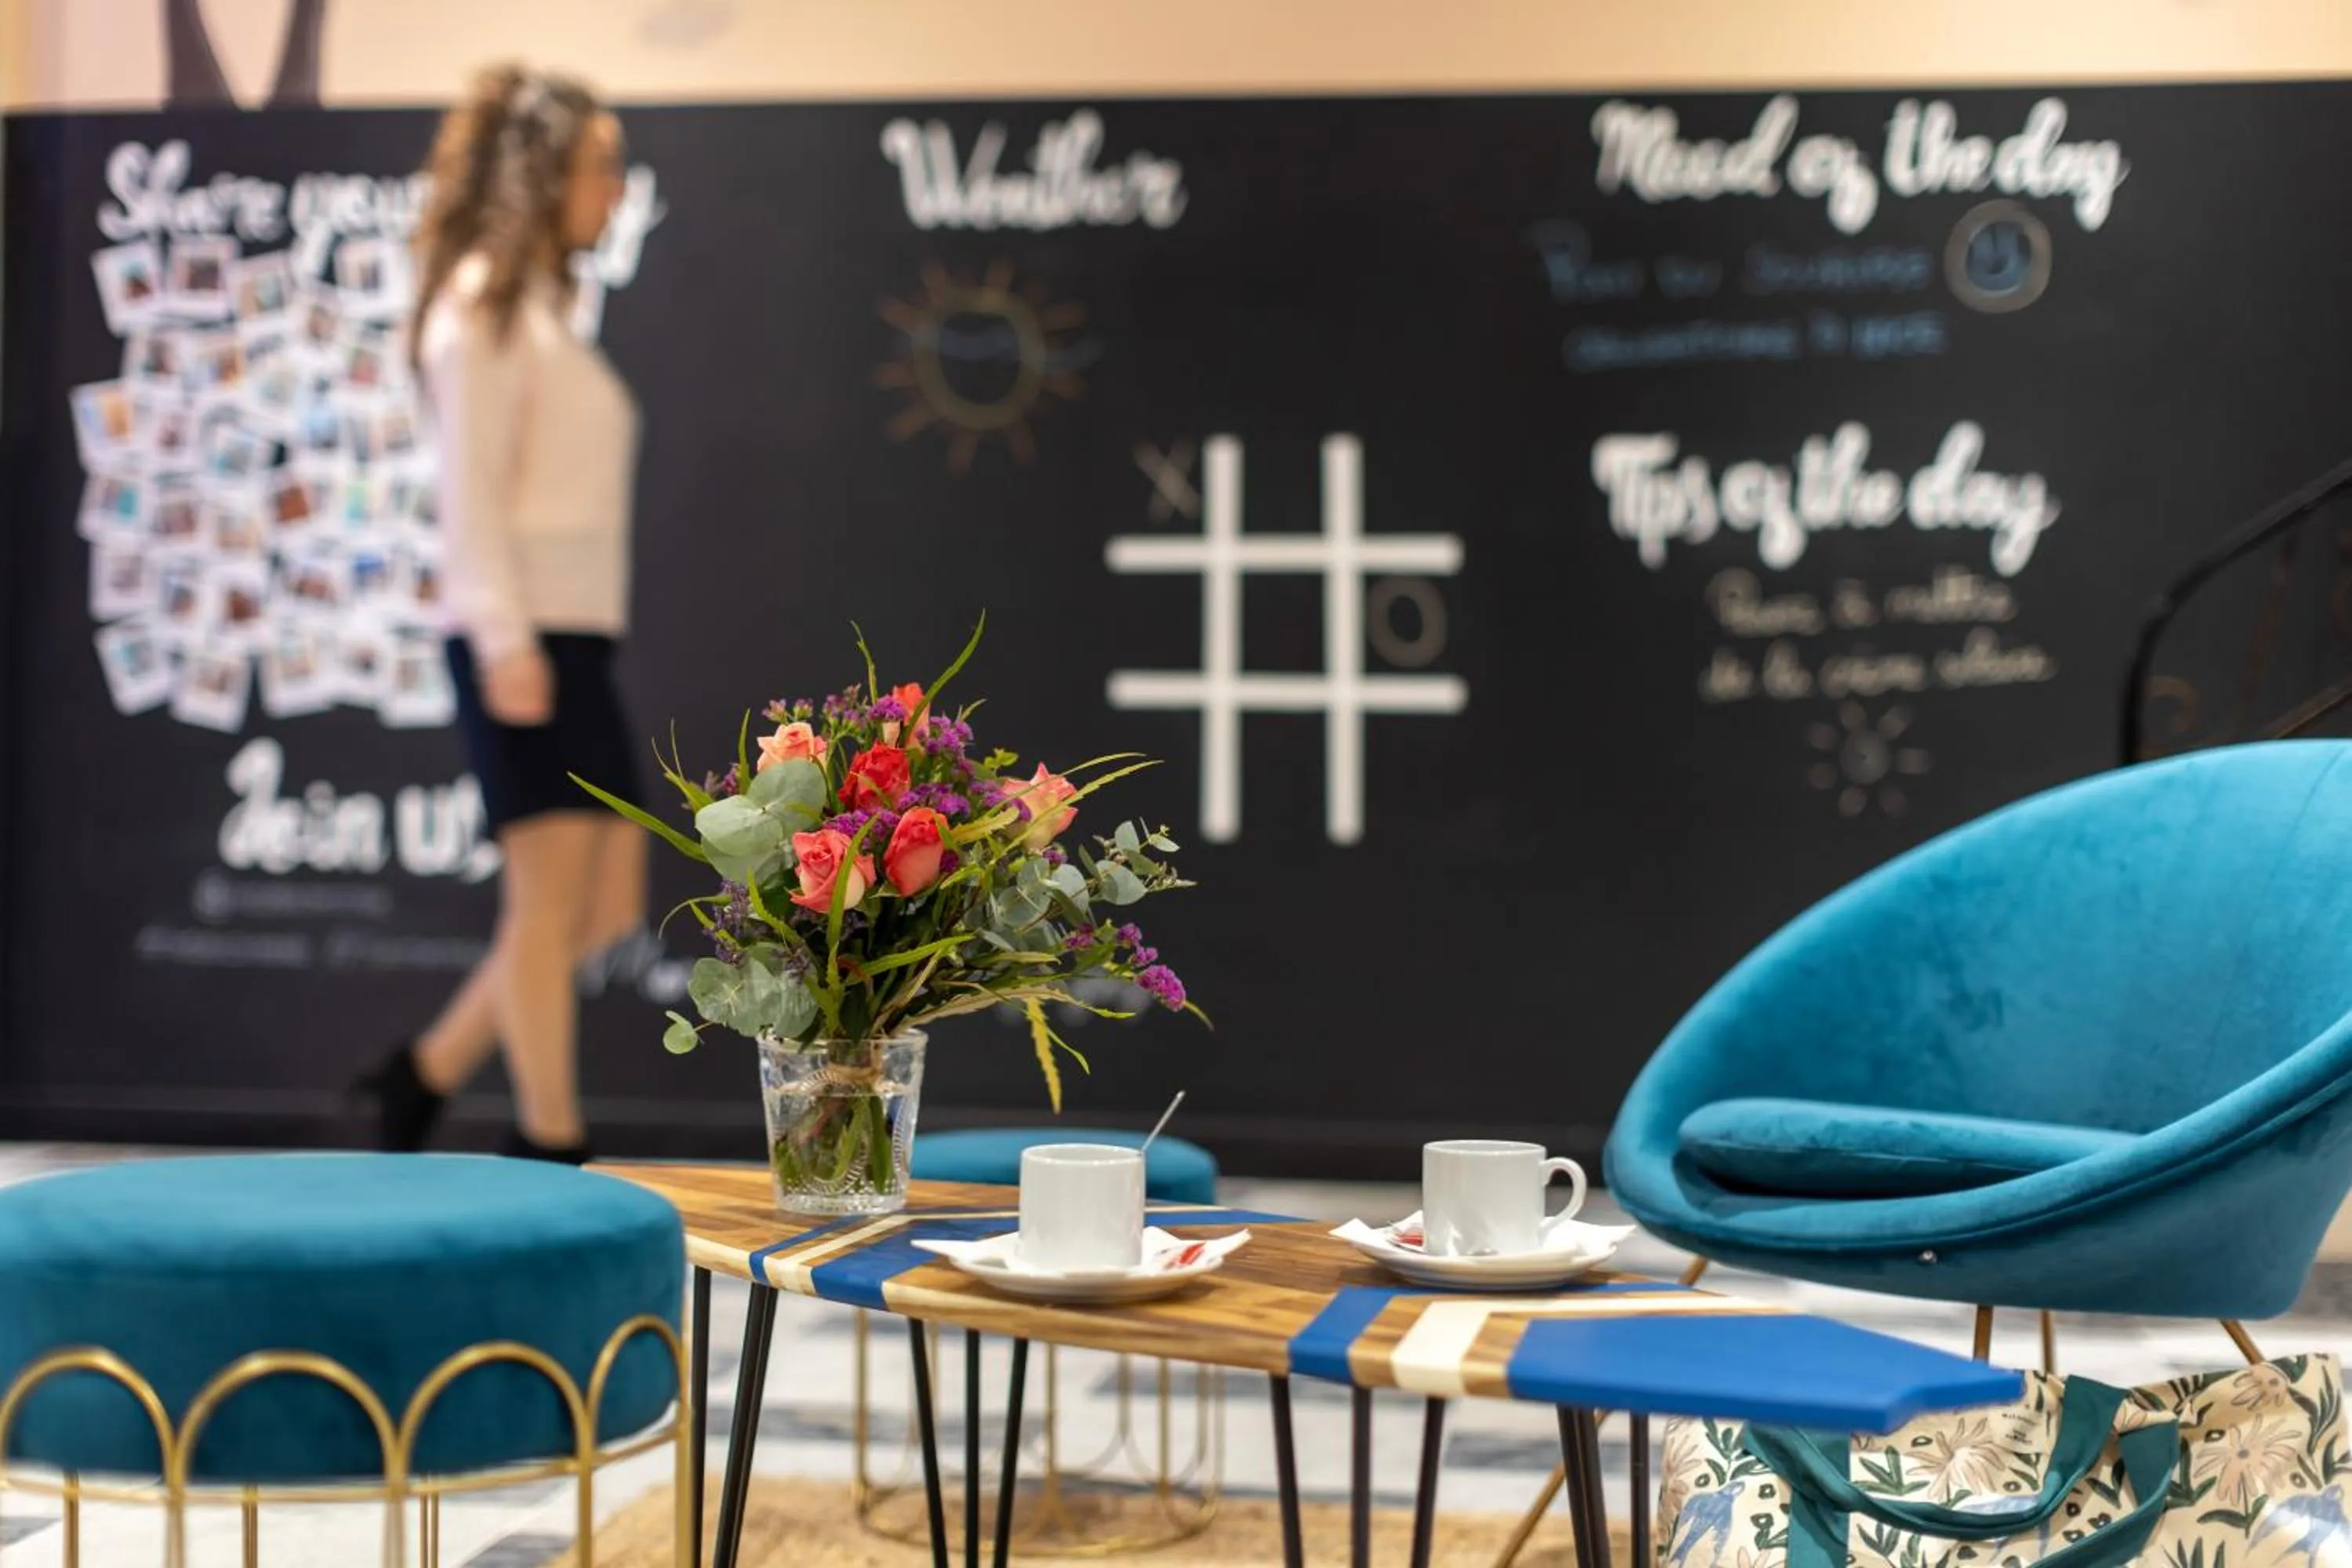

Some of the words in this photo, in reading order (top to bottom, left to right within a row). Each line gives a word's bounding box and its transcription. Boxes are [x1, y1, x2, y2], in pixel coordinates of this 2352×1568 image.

[96, 139, 286, 241] Share
[880, 109, 1188, 229] Weather
[1592, 94, 1798, 201] Mood
[1787, 133, 1879, 234] of
[1886, 97, 1994, 198] the
[1994, 96, 2130, 231] day
[1592, 431, 1719, 568] Tips
[1720, 460, 1807, 569] of
[1795, 421, 1904, 529] the
[1907, 421, 2062, 576] day
[220, 738, 389, 875] Join
